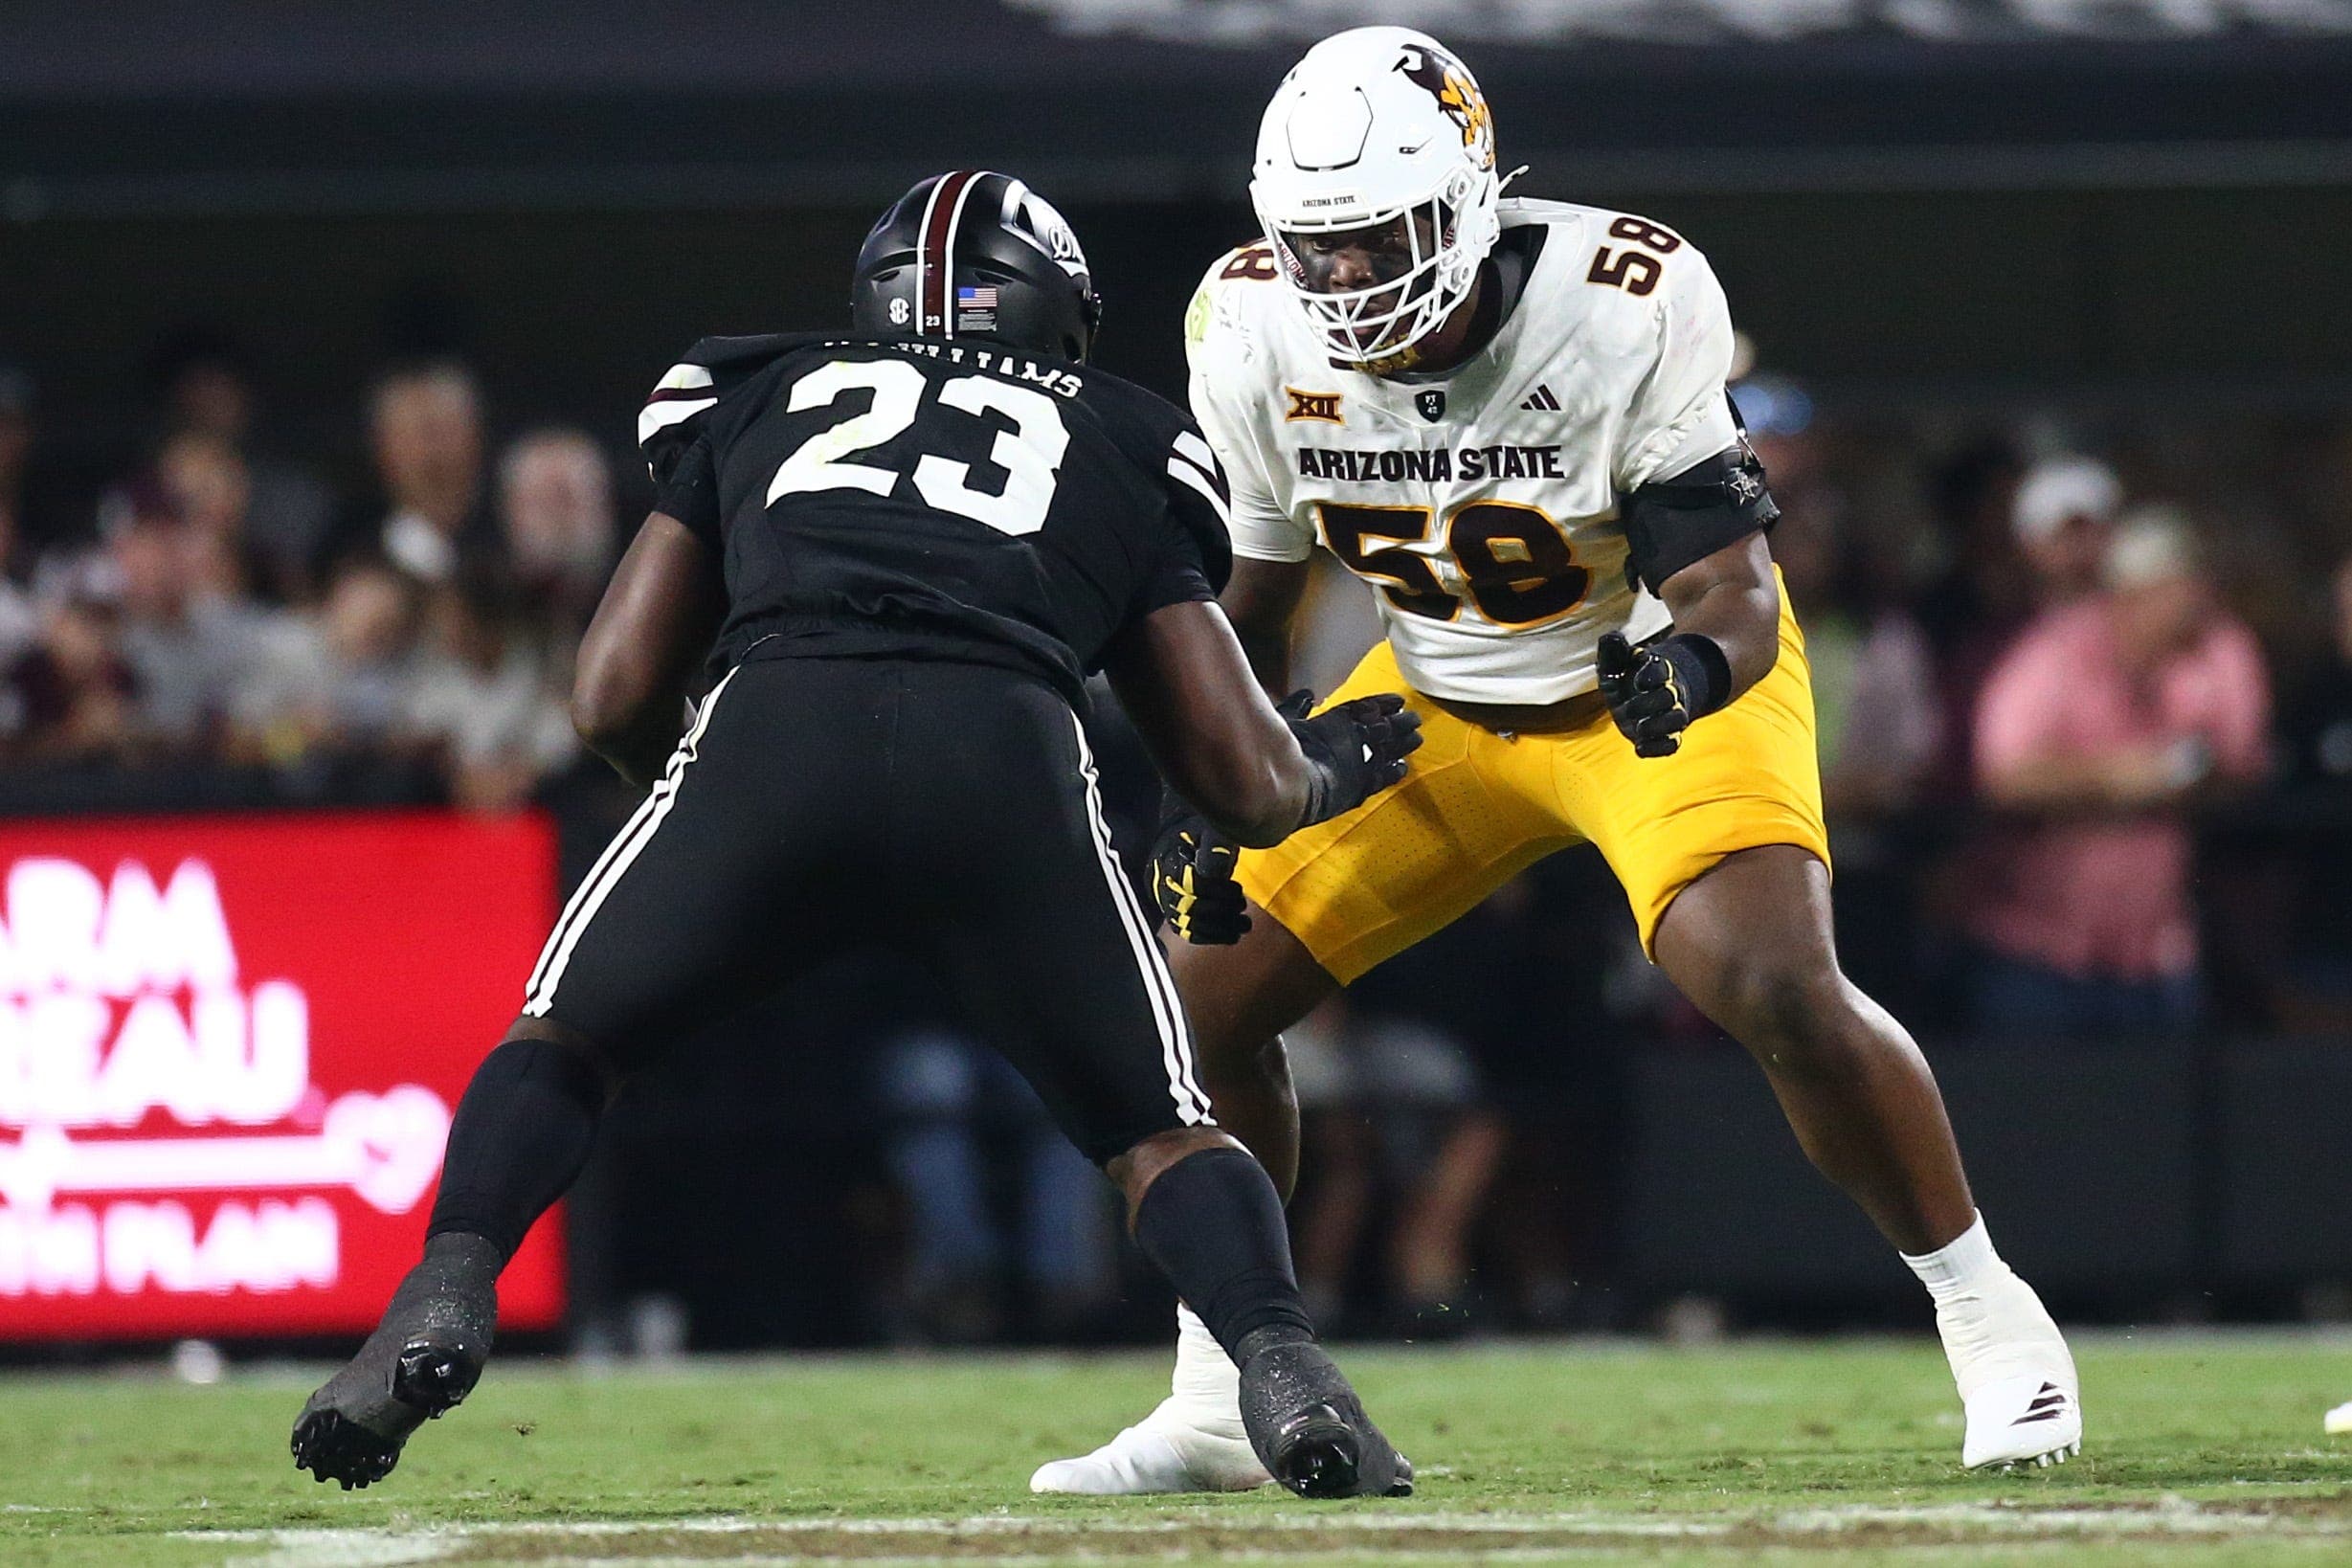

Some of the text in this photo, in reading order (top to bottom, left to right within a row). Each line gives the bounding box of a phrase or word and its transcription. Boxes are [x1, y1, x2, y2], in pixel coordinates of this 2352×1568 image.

[1302, 194, 1355, 208] ARIZONA STATE
[1586, 216, 1682, 297] 58
[926, 315, 941, 327] 23
[765, 358, 1072, 537] 23
[1299, 445, 1565, 482] ARIZONA STATE
[1314, 499, 1595, 632] 58
